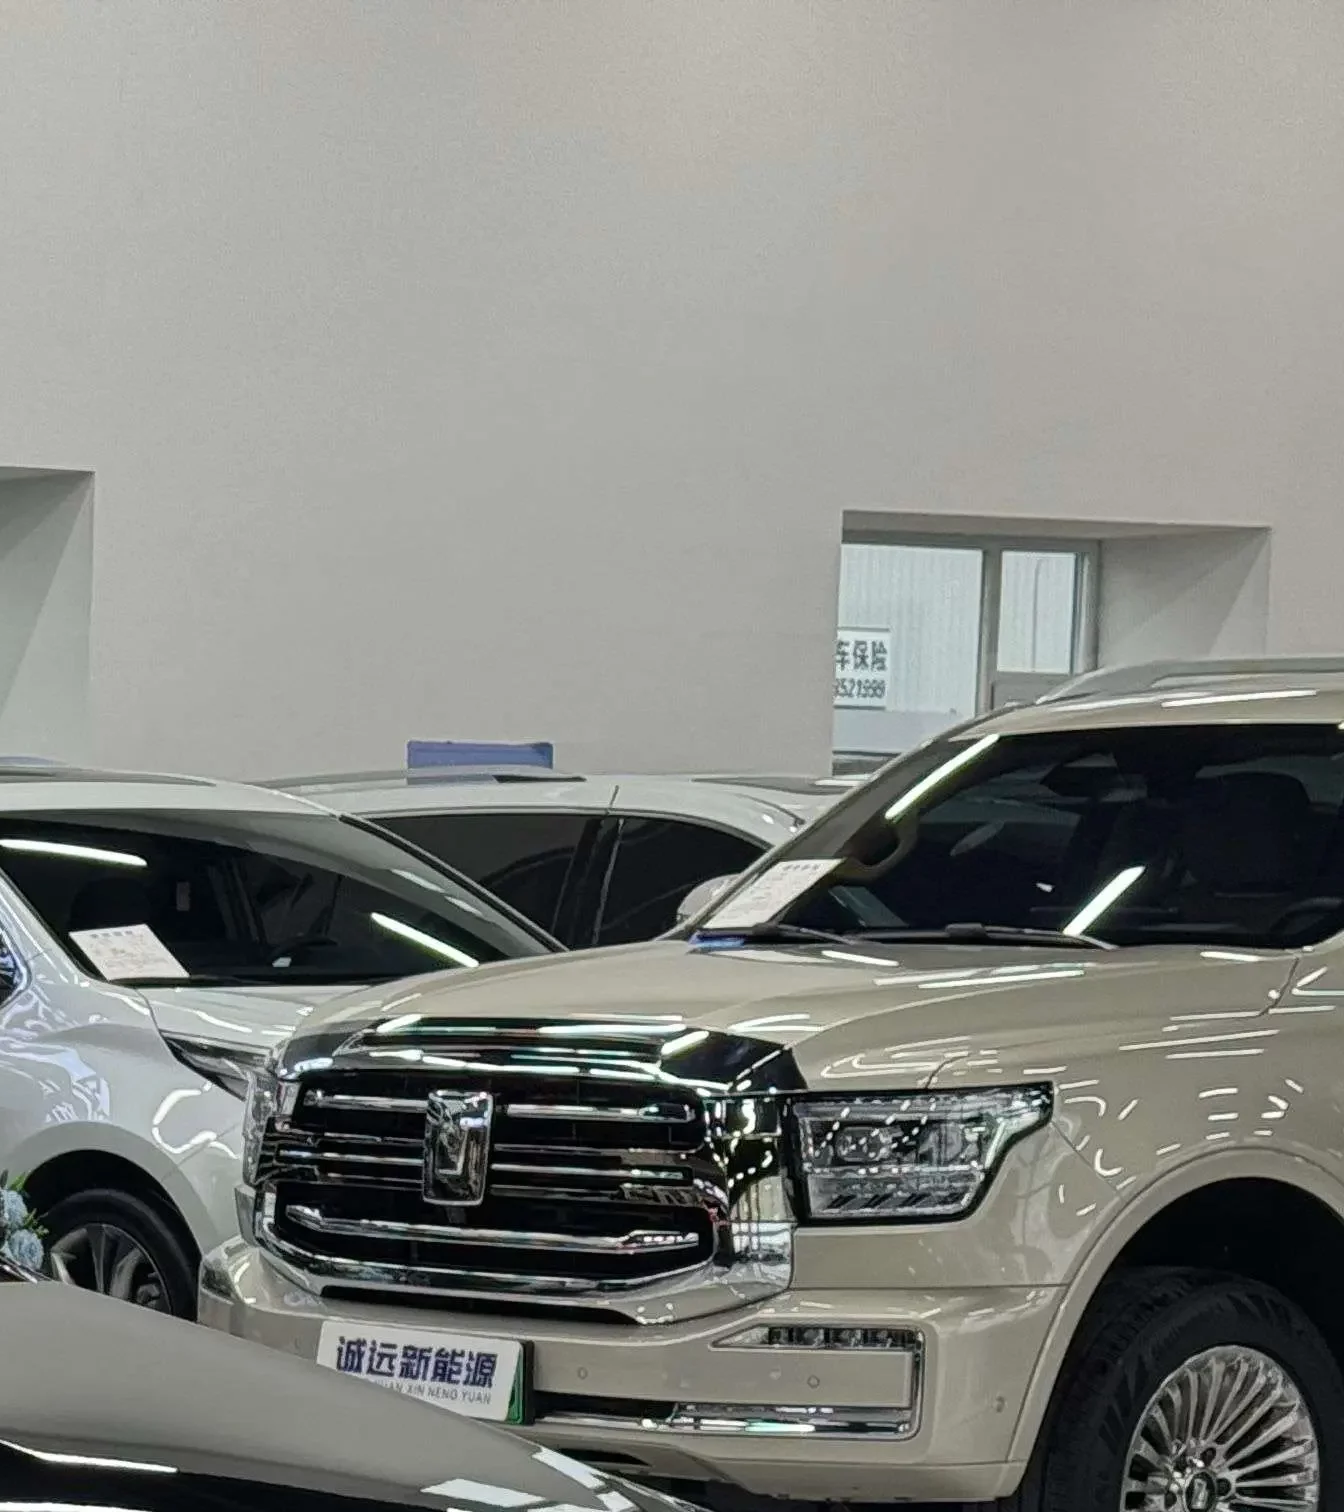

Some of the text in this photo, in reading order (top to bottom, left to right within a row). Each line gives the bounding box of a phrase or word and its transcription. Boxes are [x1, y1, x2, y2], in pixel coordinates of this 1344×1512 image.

[336, 1336, 498, 1388] 诚远新能源
